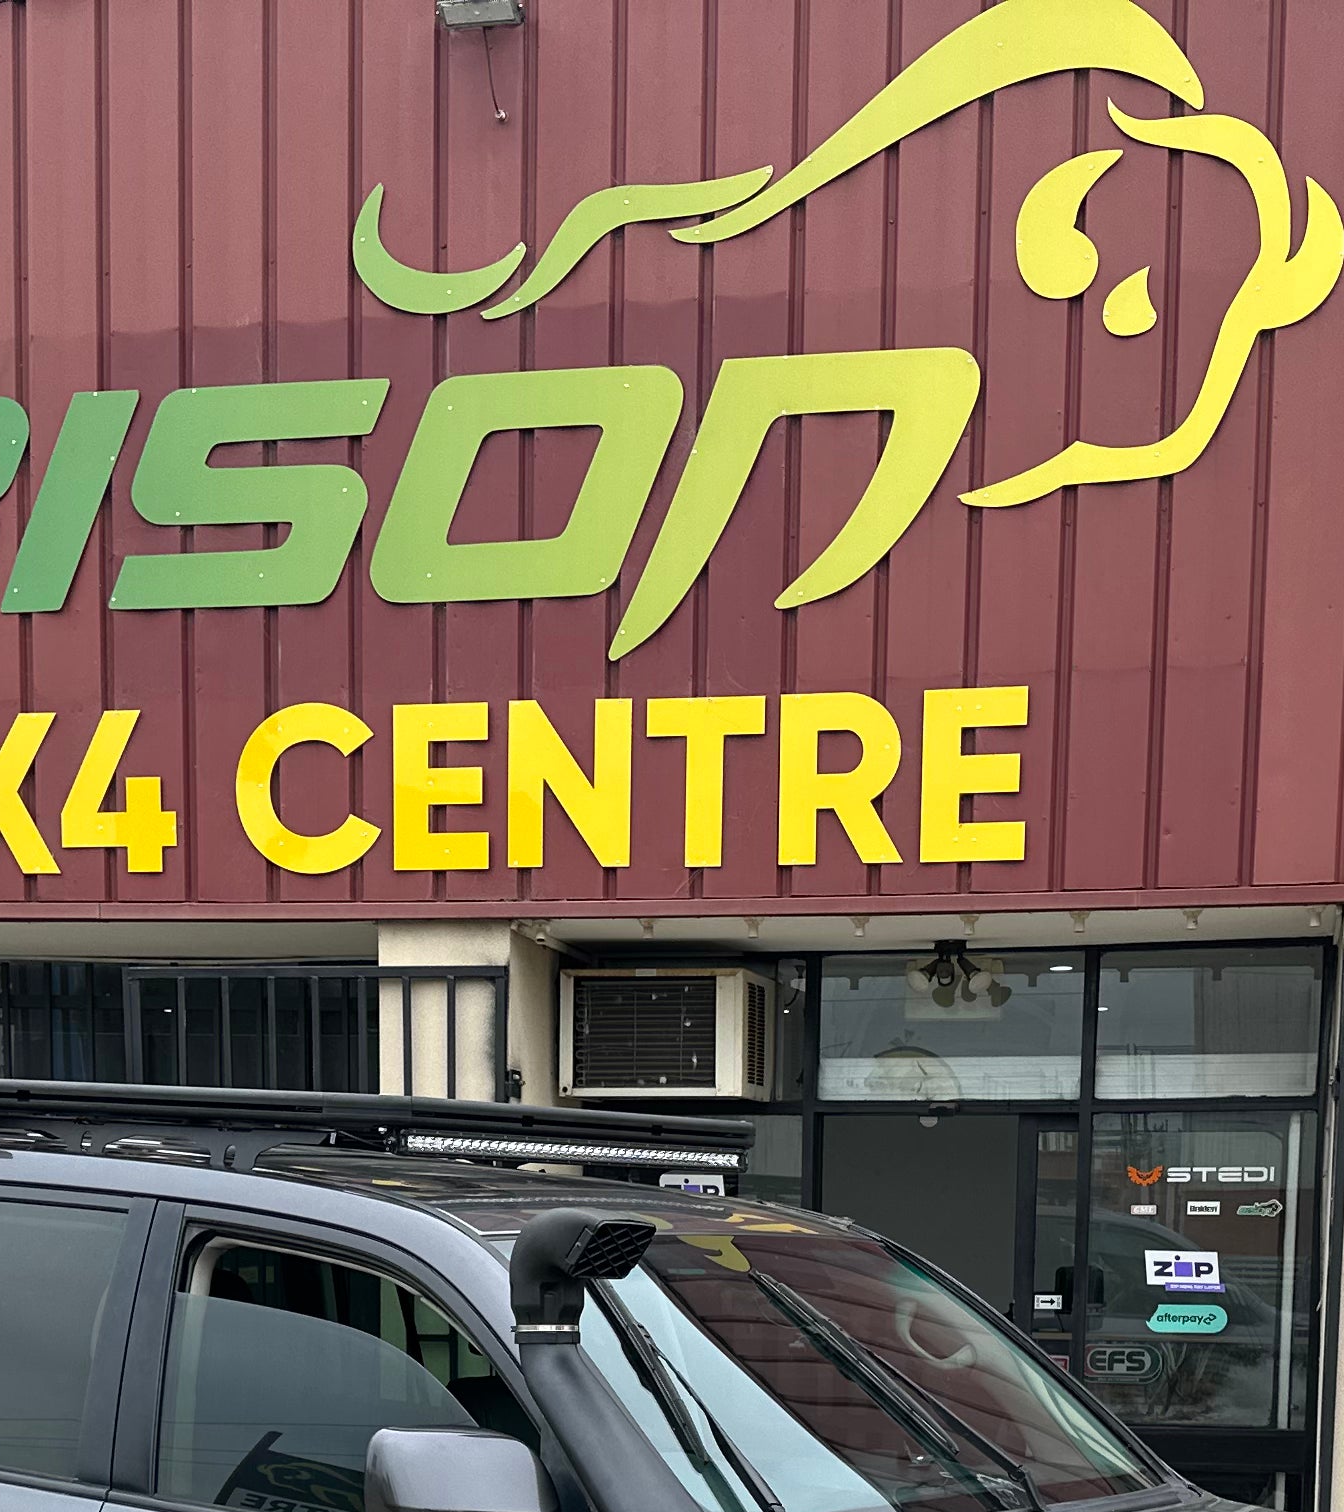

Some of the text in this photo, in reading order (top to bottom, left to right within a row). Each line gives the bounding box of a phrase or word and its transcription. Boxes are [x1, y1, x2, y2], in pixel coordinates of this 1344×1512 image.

[235, 685, 1030, 875] CENTRE
[1166, 1166, 1275, 1183] STEDI
[1157, 1313, 1203, 1325] afterpay
[1089, 1350, 1146, 1372] EFS
